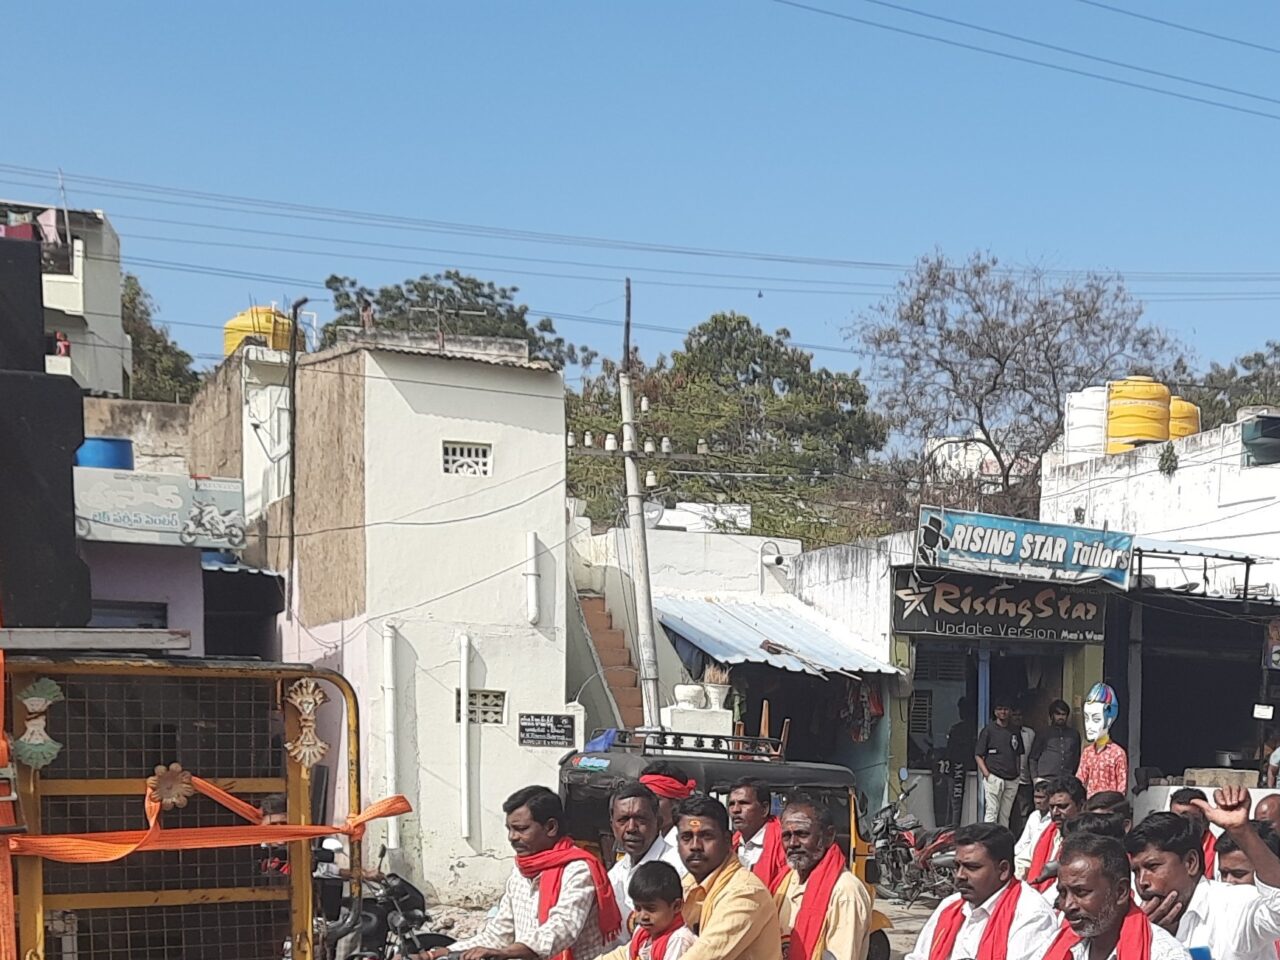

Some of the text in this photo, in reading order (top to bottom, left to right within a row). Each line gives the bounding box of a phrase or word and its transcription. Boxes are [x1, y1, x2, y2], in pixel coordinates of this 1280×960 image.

[949, 524, 1016, 557] RISING
[1019, 533, 1067, 563] STAR
[1071, 541, 1130, 570] Tailors
[935, 619, 993, 635] Update
[998, 622, 1056, 640] Version
